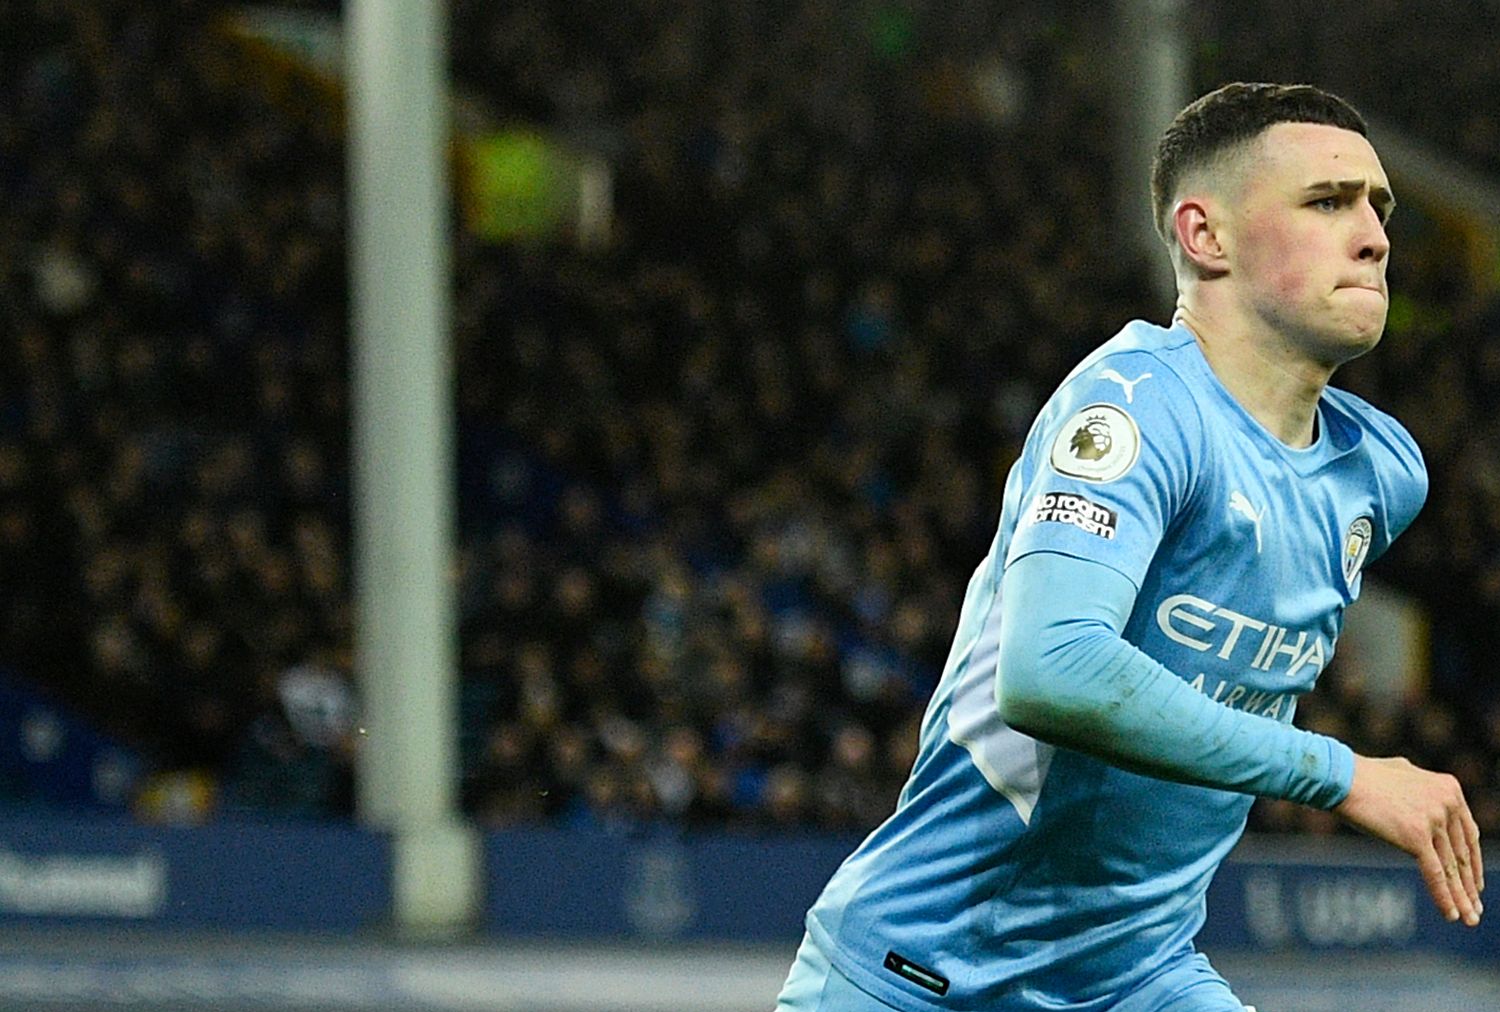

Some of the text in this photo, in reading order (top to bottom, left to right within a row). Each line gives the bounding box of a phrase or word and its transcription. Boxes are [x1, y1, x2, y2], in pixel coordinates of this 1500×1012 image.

[1056, 495, 1110, 525] room
[1156, 594, 1325, 681] ETIHA
[1190, 672, 1298, 723] AIRWA
